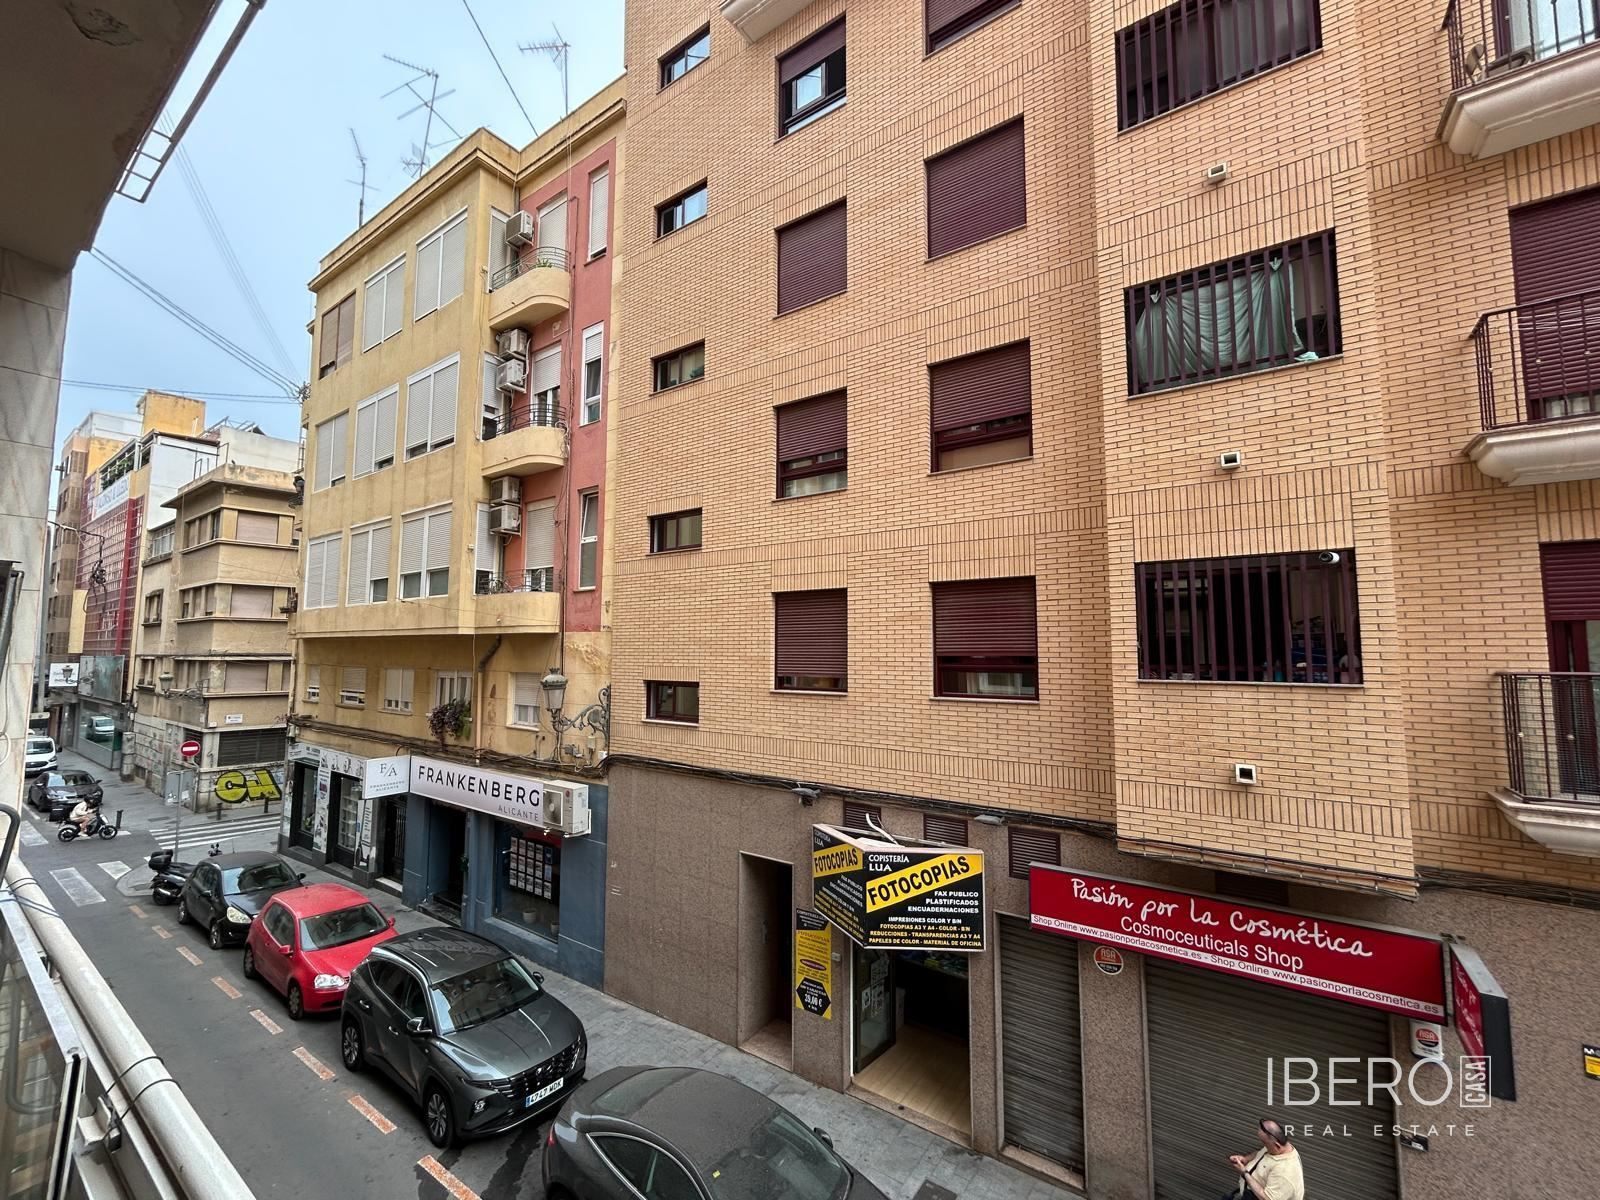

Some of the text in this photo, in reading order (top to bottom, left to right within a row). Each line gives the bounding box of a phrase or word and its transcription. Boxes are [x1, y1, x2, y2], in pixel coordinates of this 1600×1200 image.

[418, 765, 540, 807] FRANKENBERG
[498, 804, 539, 822] ALICANTE
[814, 848, 858, 873] FOTOCOPIAS
[867, 856, 970, 906] FOTOCOPIAS
[868, 854, 909, 863] COPISTERÍA
[1071, 878, 1134, 909] Pasión
[1141, 900, 1179, 922] por
[1230, 911, 1373, 957] Cosmética
[1033, 915, 1053, 927] Shop
[1054, 919, 1078, 931] Online
[1079, 925, 1202, 960] www.pasionporlacosmetica.es
[1211, 955, 1235, 969] Shop
[1238, 961, 1270, 976] Online
[1272, 969, 1439, 1014] www.pasionporlacosmetica.es
[1120, 916, 1304, 972] Cosmoceuticals Shop
